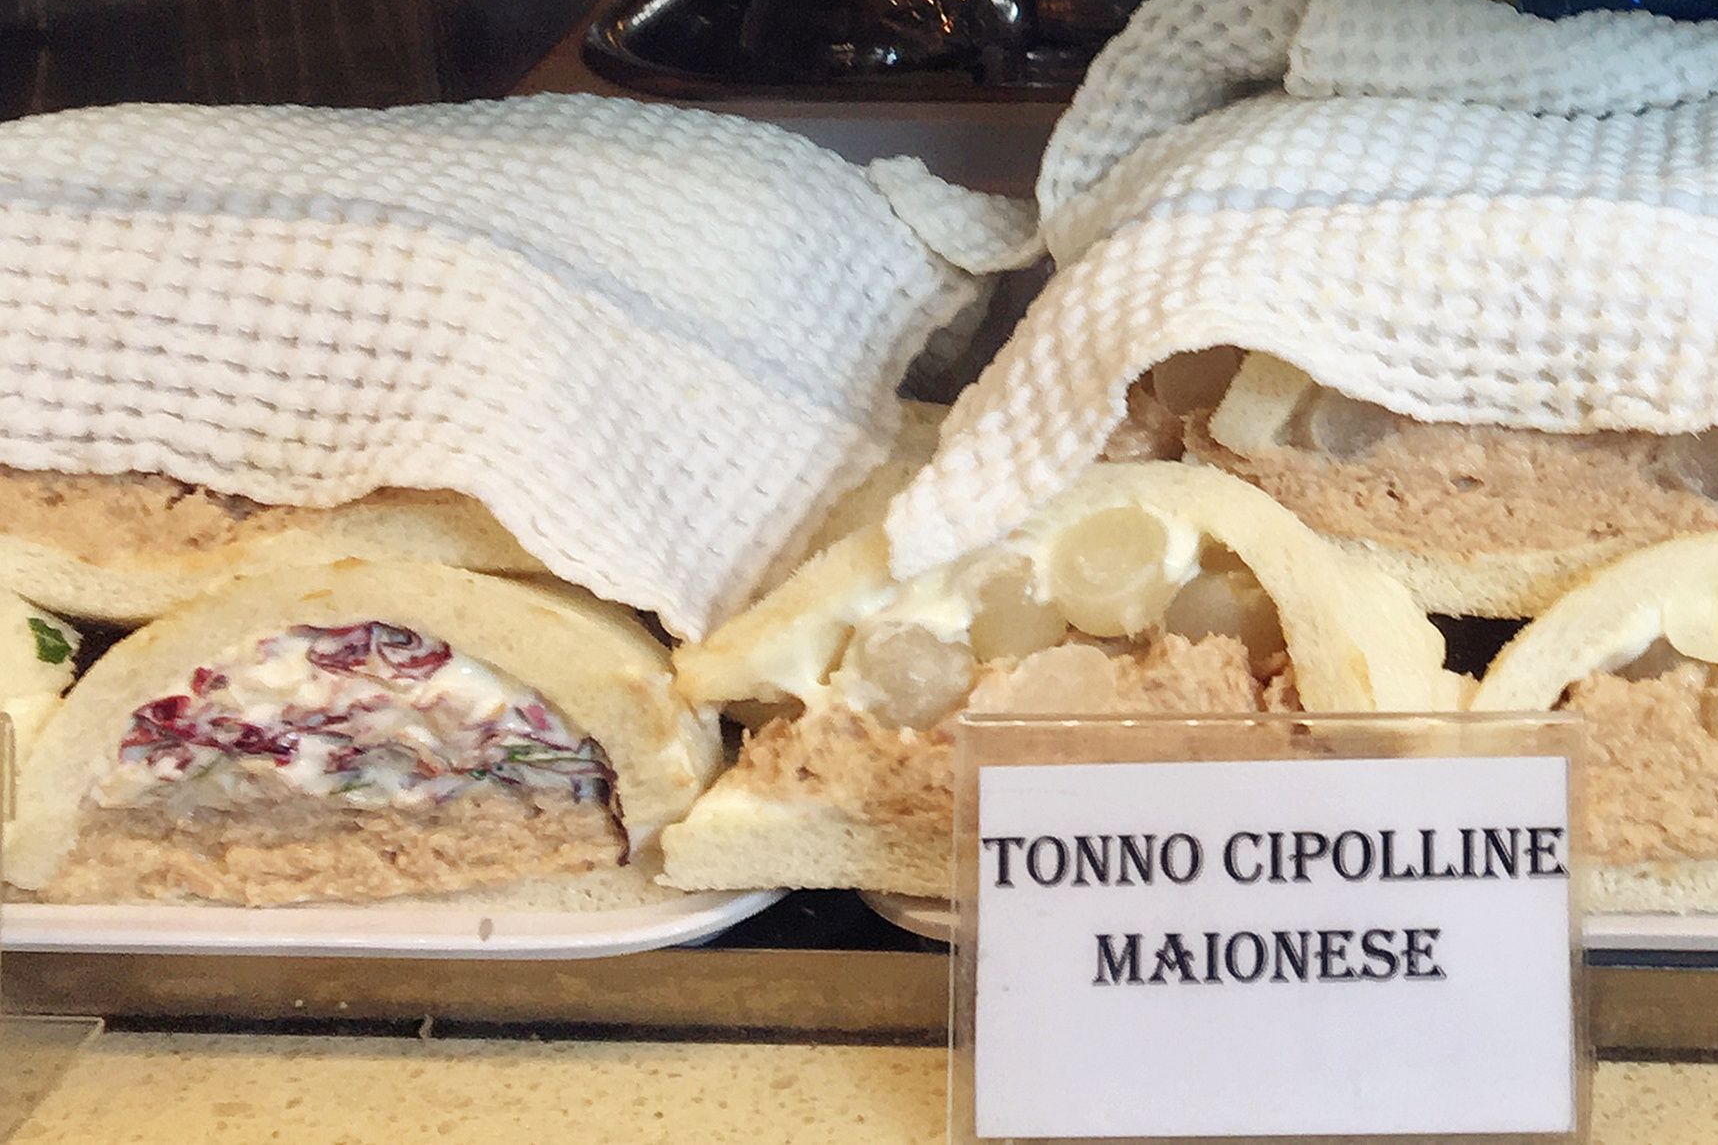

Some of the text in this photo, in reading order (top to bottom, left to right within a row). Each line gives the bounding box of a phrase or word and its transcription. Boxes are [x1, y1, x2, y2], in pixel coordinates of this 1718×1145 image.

[982, 826, 1571, 888] TONNO CIPOLLINE
[1092, 927, 1447, 987] MAIONESE
